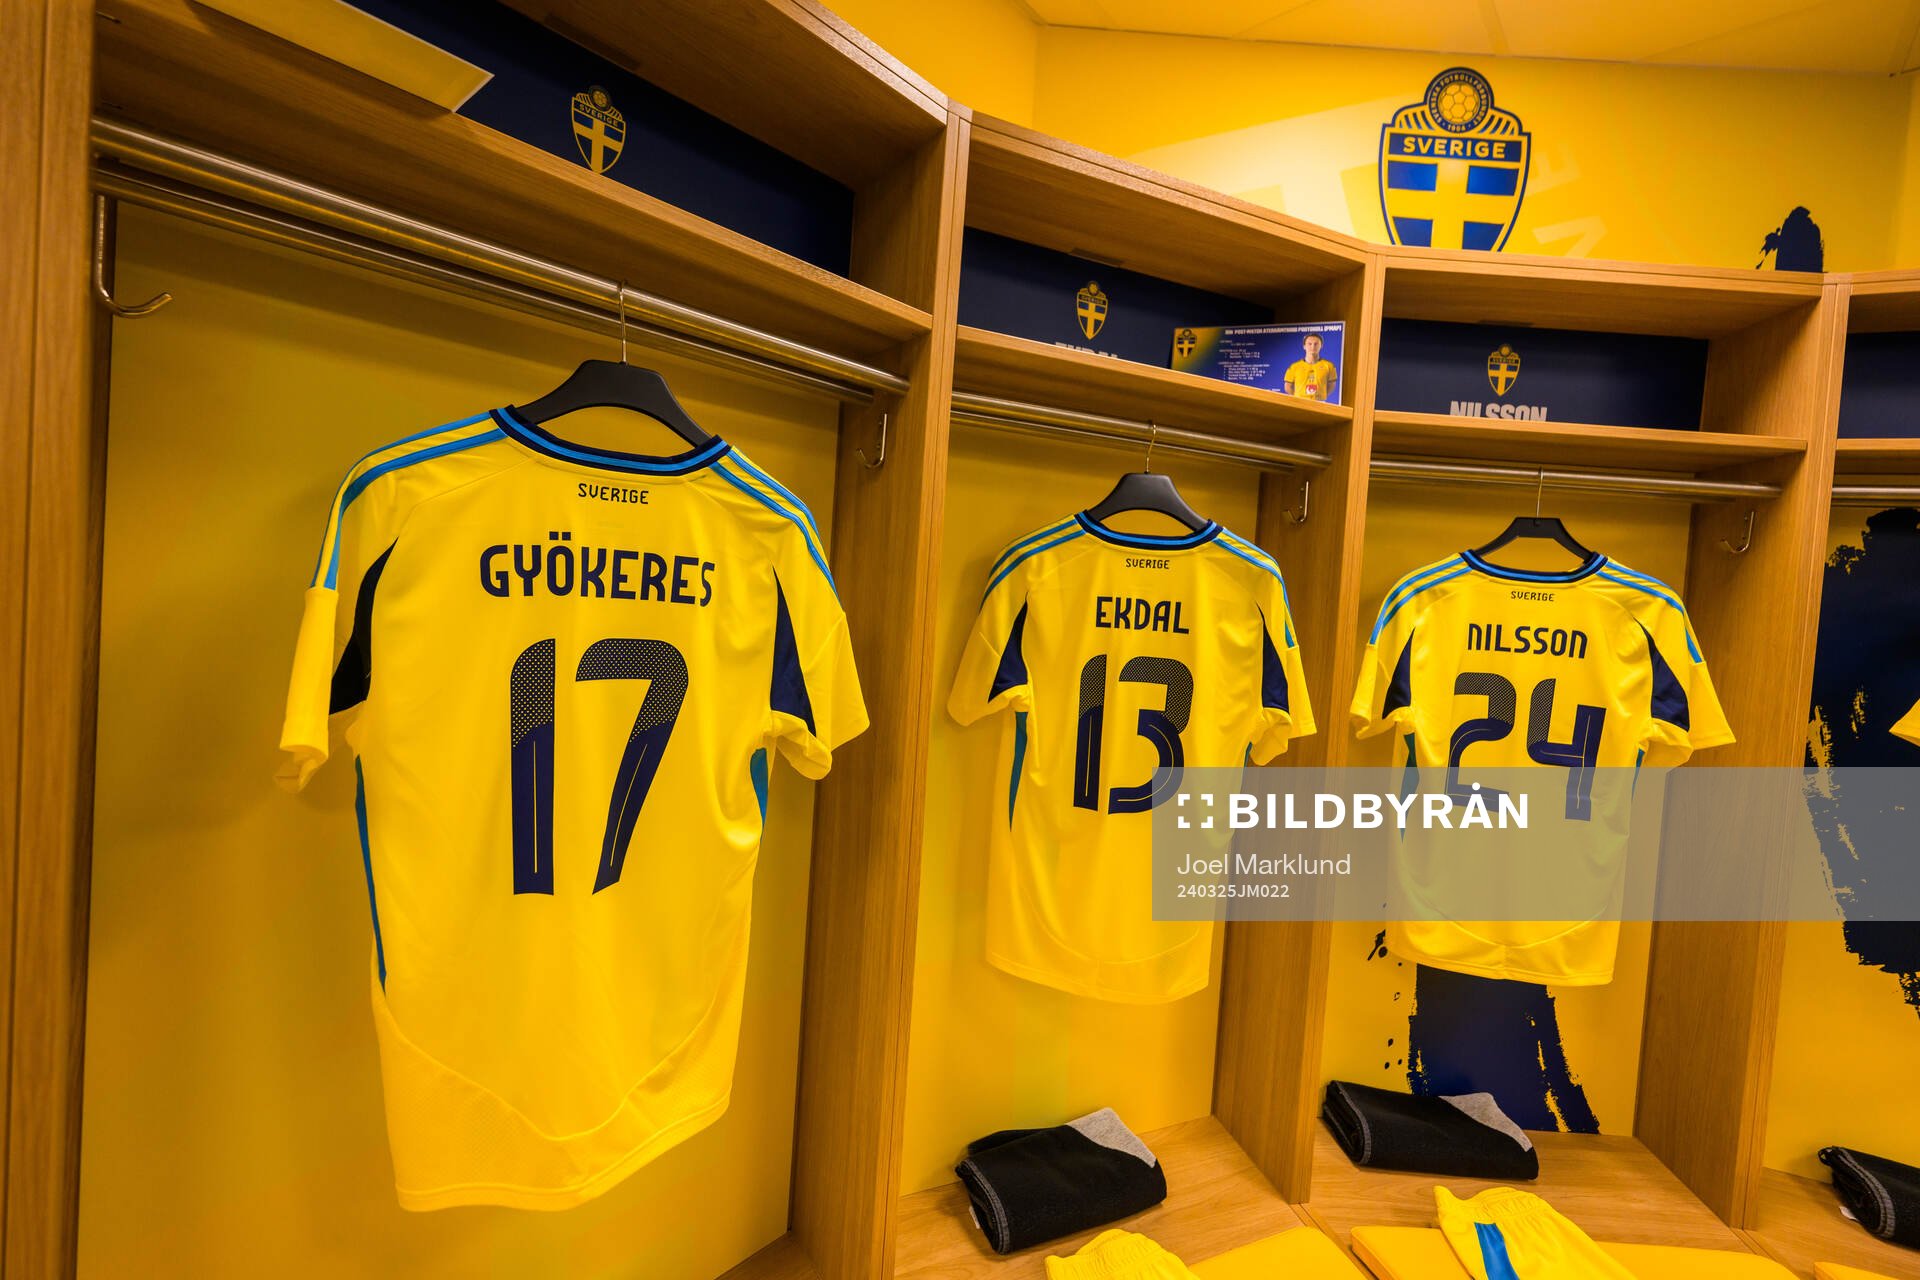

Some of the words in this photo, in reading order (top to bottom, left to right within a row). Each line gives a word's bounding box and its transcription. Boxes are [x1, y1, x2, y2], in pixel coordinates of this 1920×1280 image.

[579, 103, 619, 127] SVERIGE
[1403, 136, 1506, 159] SVERIGE
[578, 483, 649, 504] SVERIGE
[480, 531, 715, 607] GYÖKERES
[1125, 558, 1170, 569] SVERIGE
[1510, 590, 1555, 601] SVERIGE
[1095, 596, 1189, 635] EKDAL
[1468, 623, 1588, 659] NILSSON
[1073, 654, 1194, 814] 13
[1444, 672, 1607, 821] 24
[510, 638, 689, 896] 17
